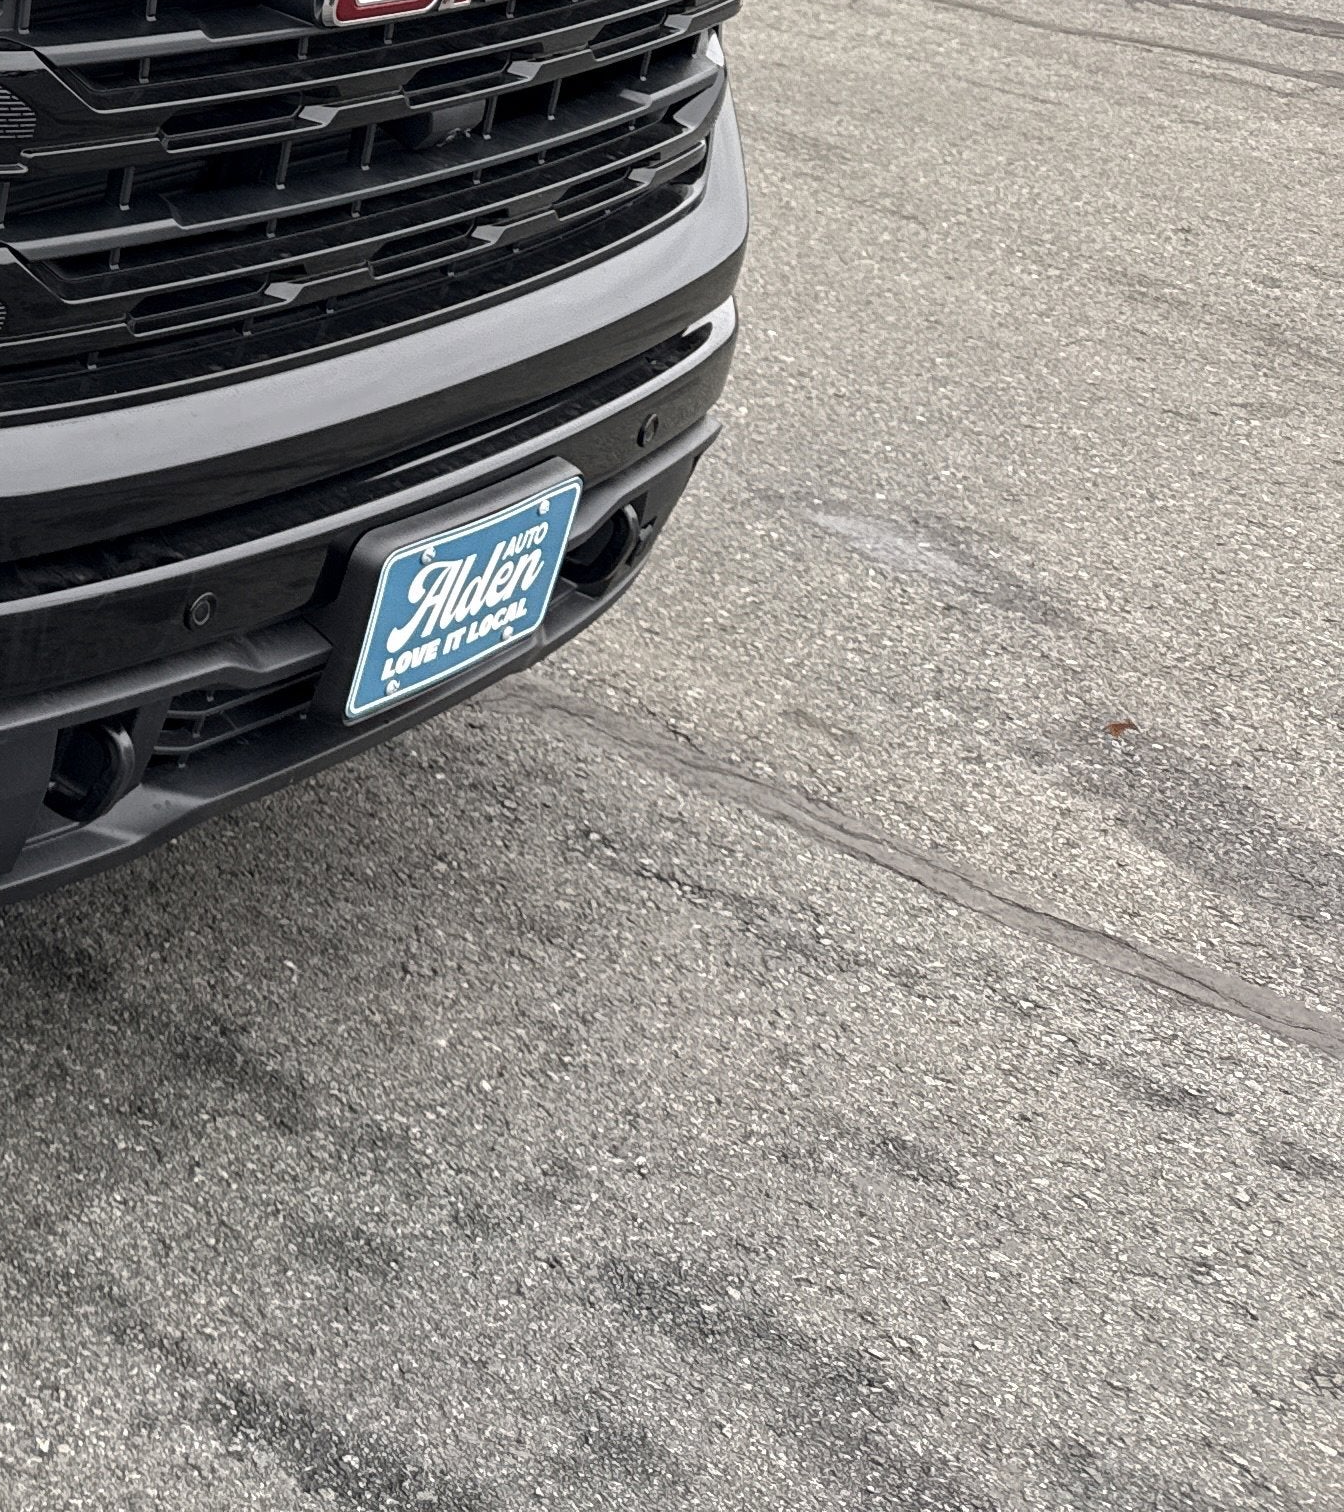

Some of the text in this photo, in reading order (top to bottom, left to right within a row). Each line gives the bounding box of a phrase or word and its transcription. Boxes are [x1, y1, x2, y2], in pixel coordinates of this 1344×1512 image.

[502, 521, 549, 560] AUTO
[386, 541, 544, 653] Alden
[381, 598, 527, 680] LOVE IT LOCAL
